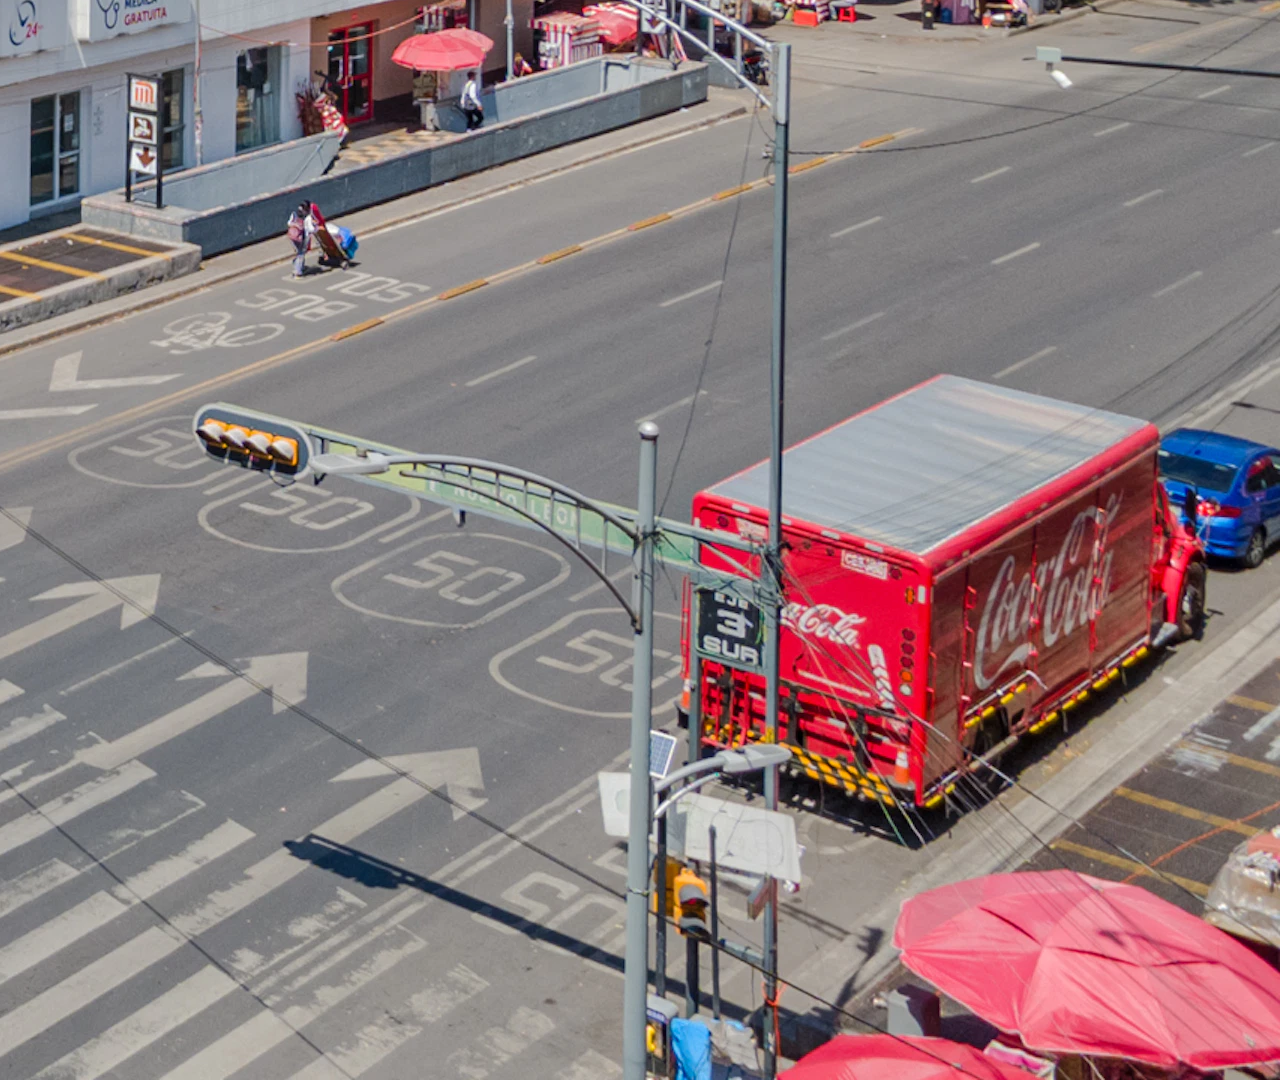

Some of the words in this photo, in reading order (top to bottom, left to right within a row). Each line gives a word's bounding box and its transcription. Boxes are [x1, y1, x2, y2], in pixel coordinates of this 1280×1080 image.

[124, 7, 168, 26] GRATUITA
[240, 482, 375, 531] 50
[384, 549, 526, 606] 50
[974, 488, 1125, 690] Coca-Cola
[716, 608, 754, 639] 3
[702, 634, 760, 668] SUR
